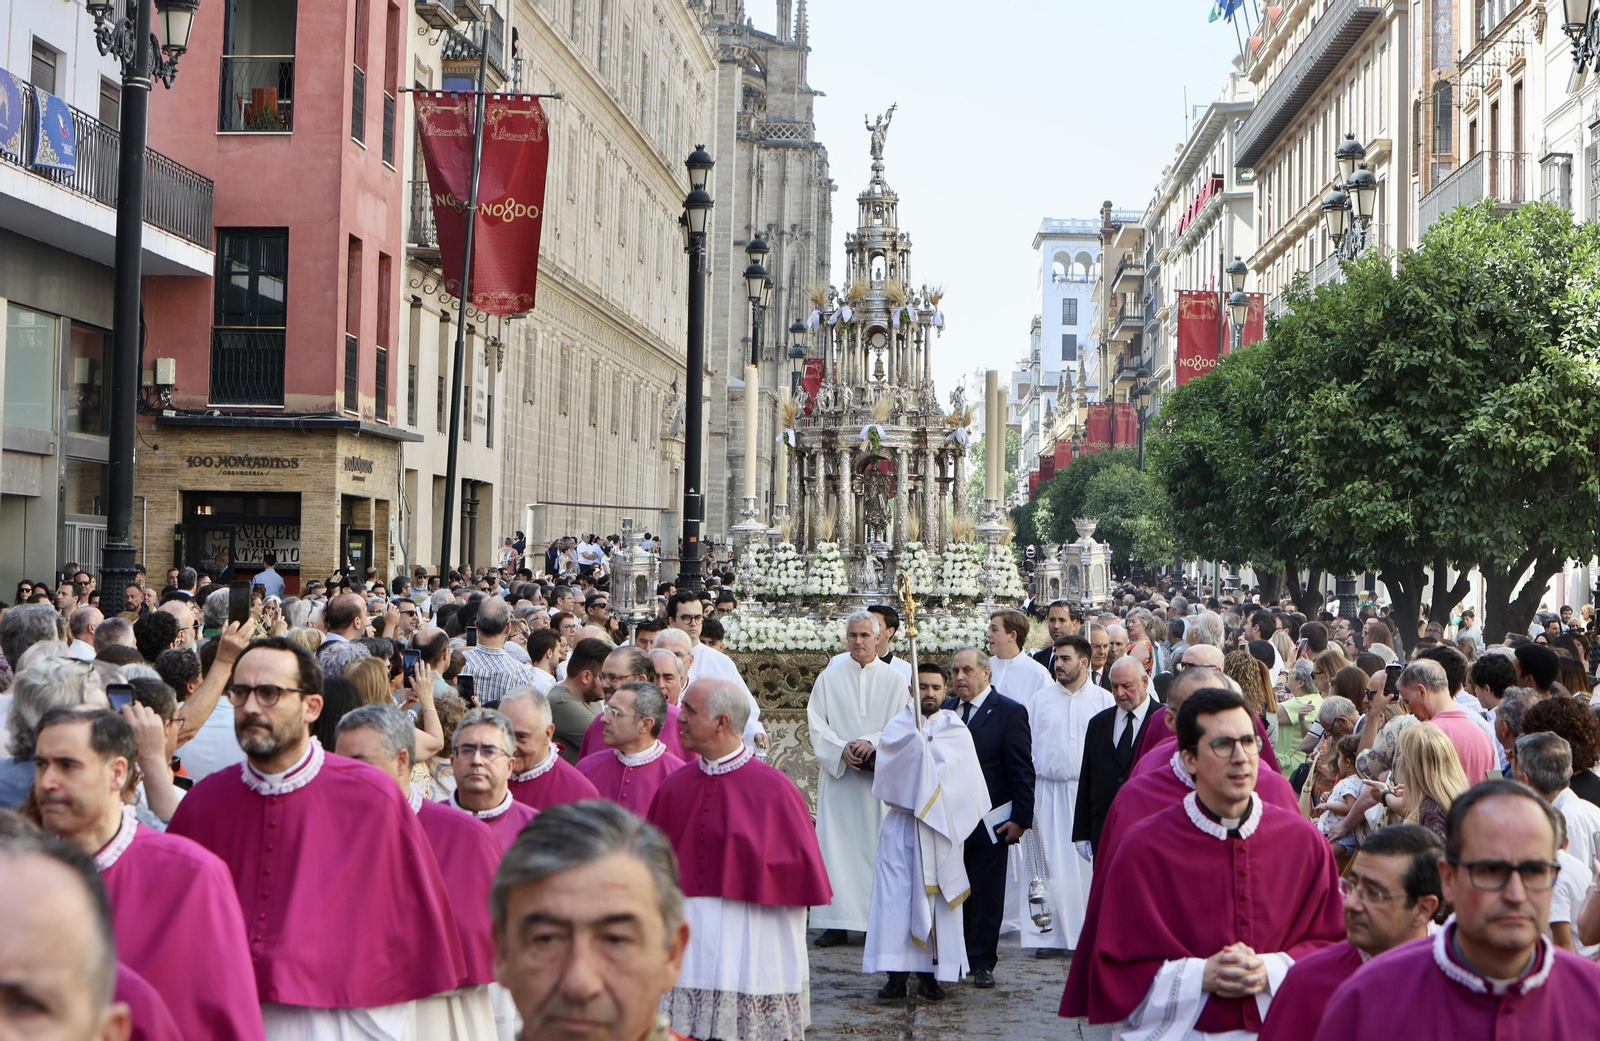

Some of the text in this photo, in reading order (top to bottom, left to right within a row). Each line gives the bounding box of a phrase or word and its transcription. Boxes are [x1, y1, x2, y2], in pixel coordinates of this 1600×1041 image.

[1056, 283, 1080, 291] AXA
[186, 454, 299, 469] 100 MONTADITOS
